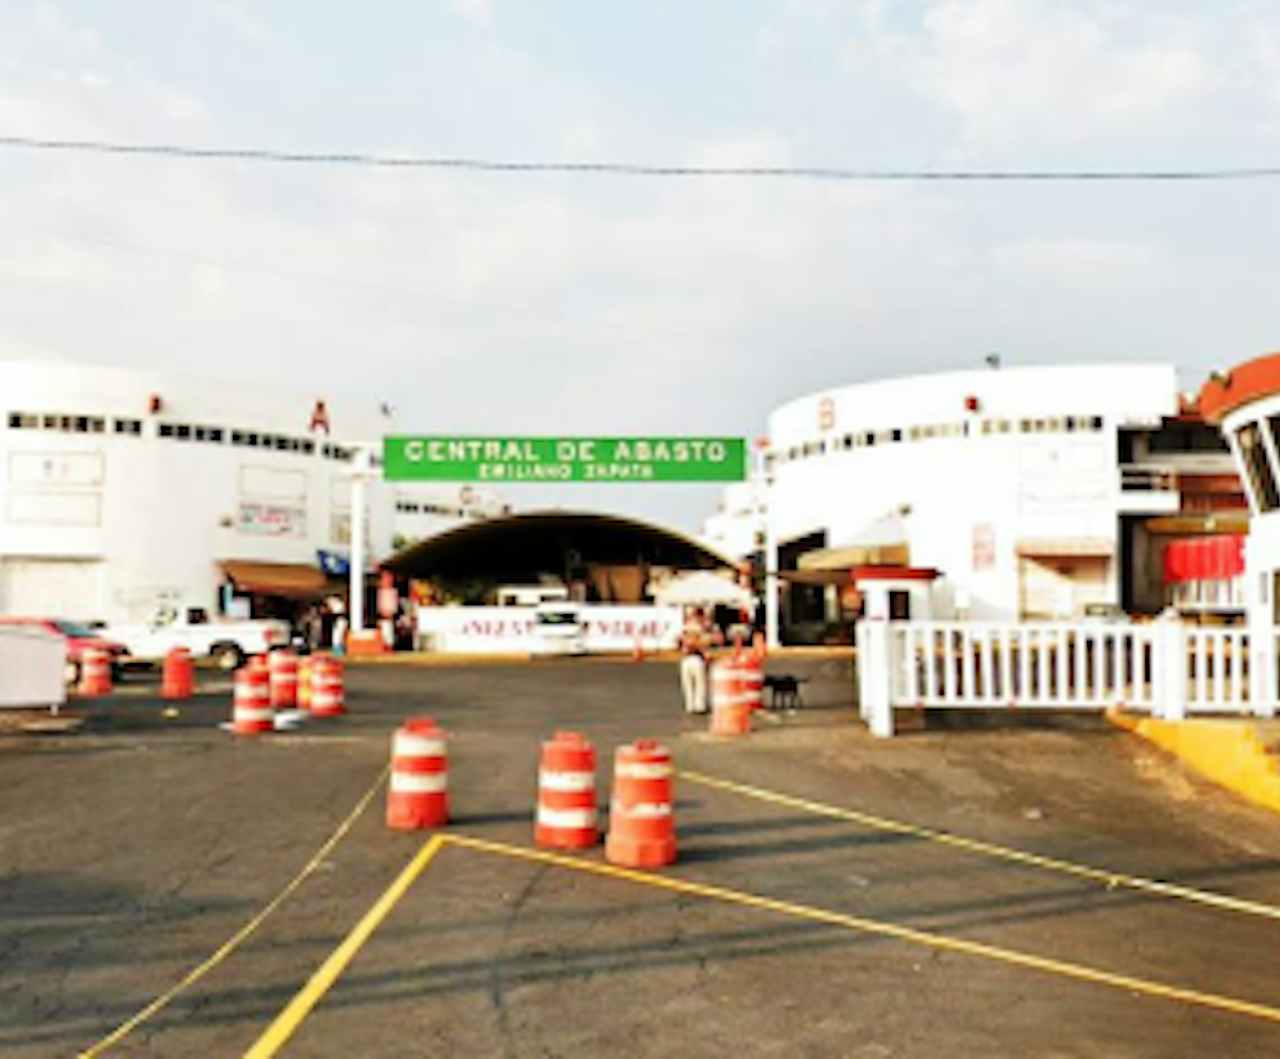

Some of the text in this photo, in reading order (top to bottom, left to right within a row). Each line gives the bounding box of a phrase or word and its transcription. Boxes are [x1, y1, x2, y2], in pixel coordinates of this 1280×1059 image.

[311, 399, 330, 434] A
[404, 441, 727, 463] CENTRAL DE ABASTO
[479, 463, 656, 479] EMILIANO ZAPATA
